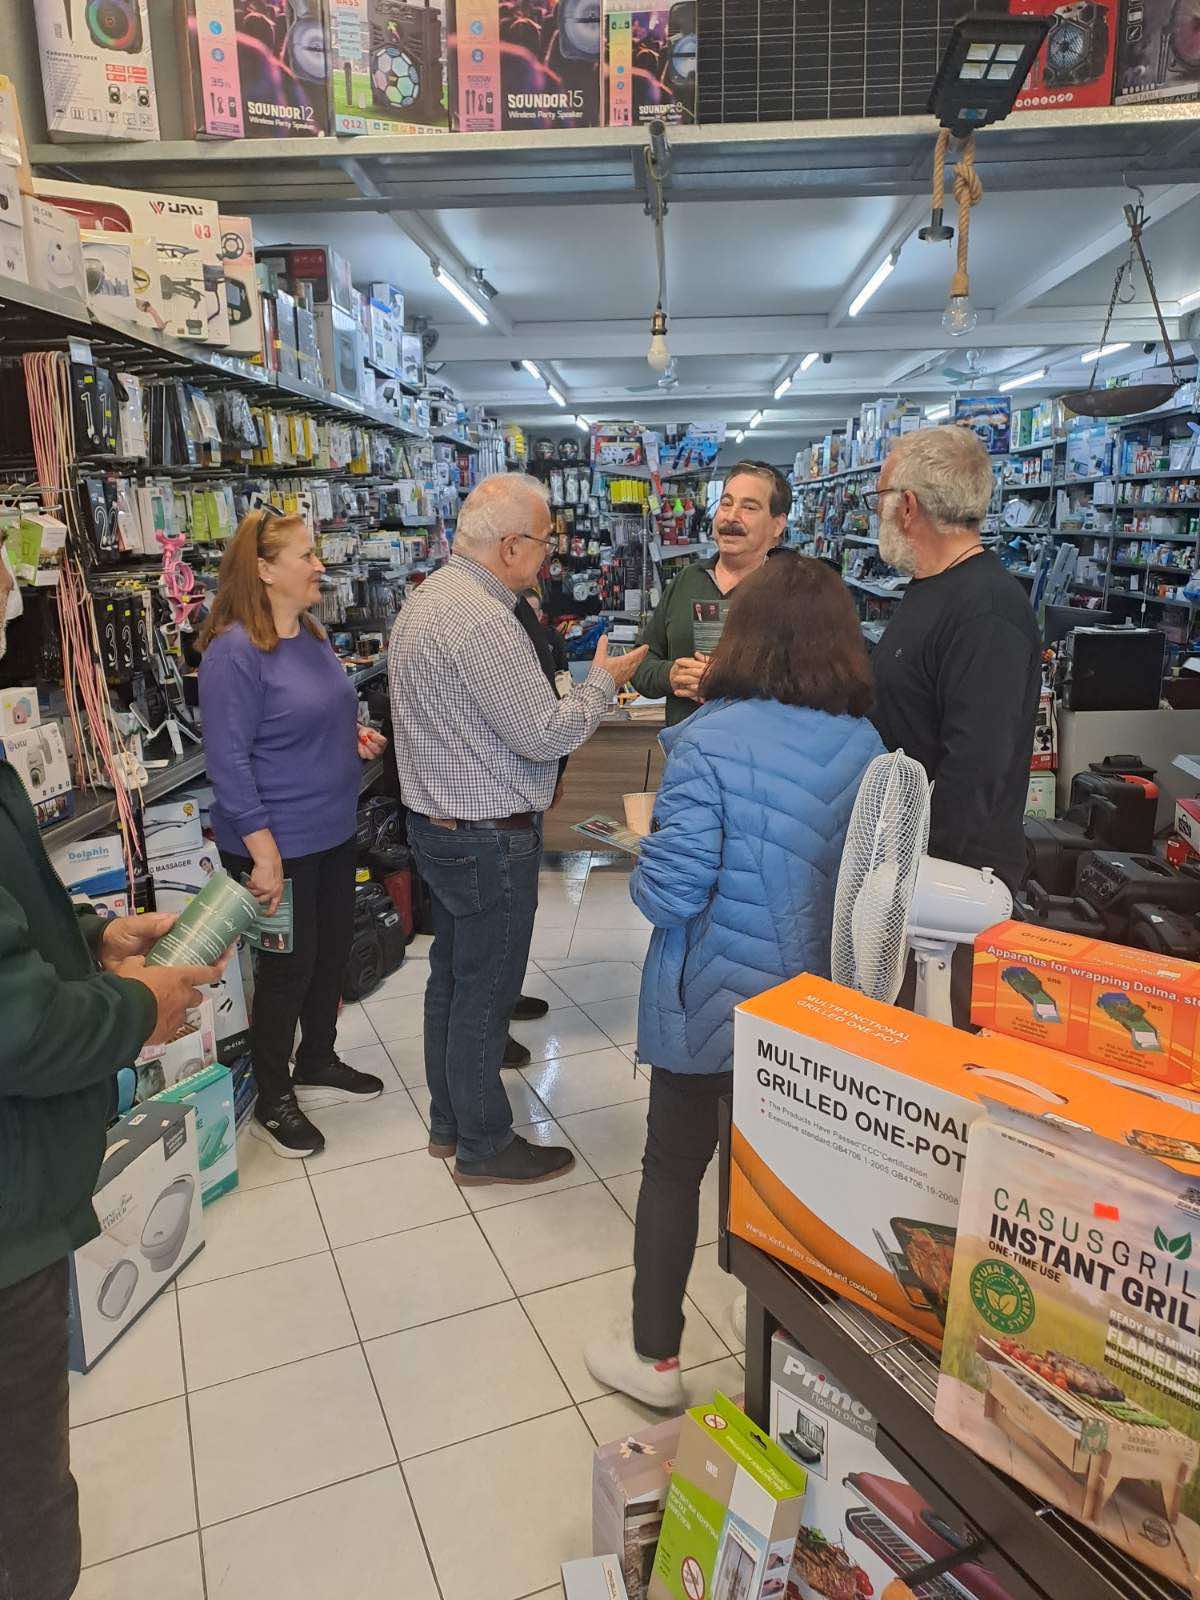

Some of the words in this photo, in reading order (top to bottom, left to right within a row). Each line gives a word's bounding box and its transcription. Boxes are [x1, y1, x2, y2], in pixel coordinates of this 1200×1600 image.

[68, 846, 109, 860] Dolphin
[155, 859, 192, 872] MASSAGER
[1021, 931, 1073, 948] Original
[987, 945, 1047, 967] Apparatus
[1050, 959, 1069, 972] for
[1070, 967, 1130, 991] wrapping
[796, 999, 848, 1025] GRILLED
[847, 1019, 905, 1045] ONE-POT
[806, 994, 911, 1042] MULTIFUNCTIONAL
[757, 1039, 969, 1144] MULTIFUNCTIONAL
[756, 1067, 848, 1122] GRILLED
[855, 1112, 967, 1173] ONE-POT
[767, 1112, 799, 1132] Executive
[782, 1106, 812, 1126] Products
[813, 1121, 831, 1134] Have
[882, 1153, 928, 1180] Certification
[974, 1264, 1006, 1298] NATURAL
[988, 1240, 1038, 1271] ONE-TIME
[1039, 1264, 1062, 1284] USE
[989, 1214, 1116, 1293] INSTANT
[1121, 1276, 1200, 1338] GRIL
[1109, 1308, 1143, 1330] READY
[1103, 1355, 1143, 1381] REDUCED
[1106, 1325, 1200, 1384] FLAMELES
[1106, 1340, 1117, 1351] NO
[1118, 1345, 1151, 1368] LIGHTER
[1151, 1364, 1175, 1381] FLUID
[1176, 1375, 1200, 1393] NEED
[782, 1354, 873, 1421] Primo
